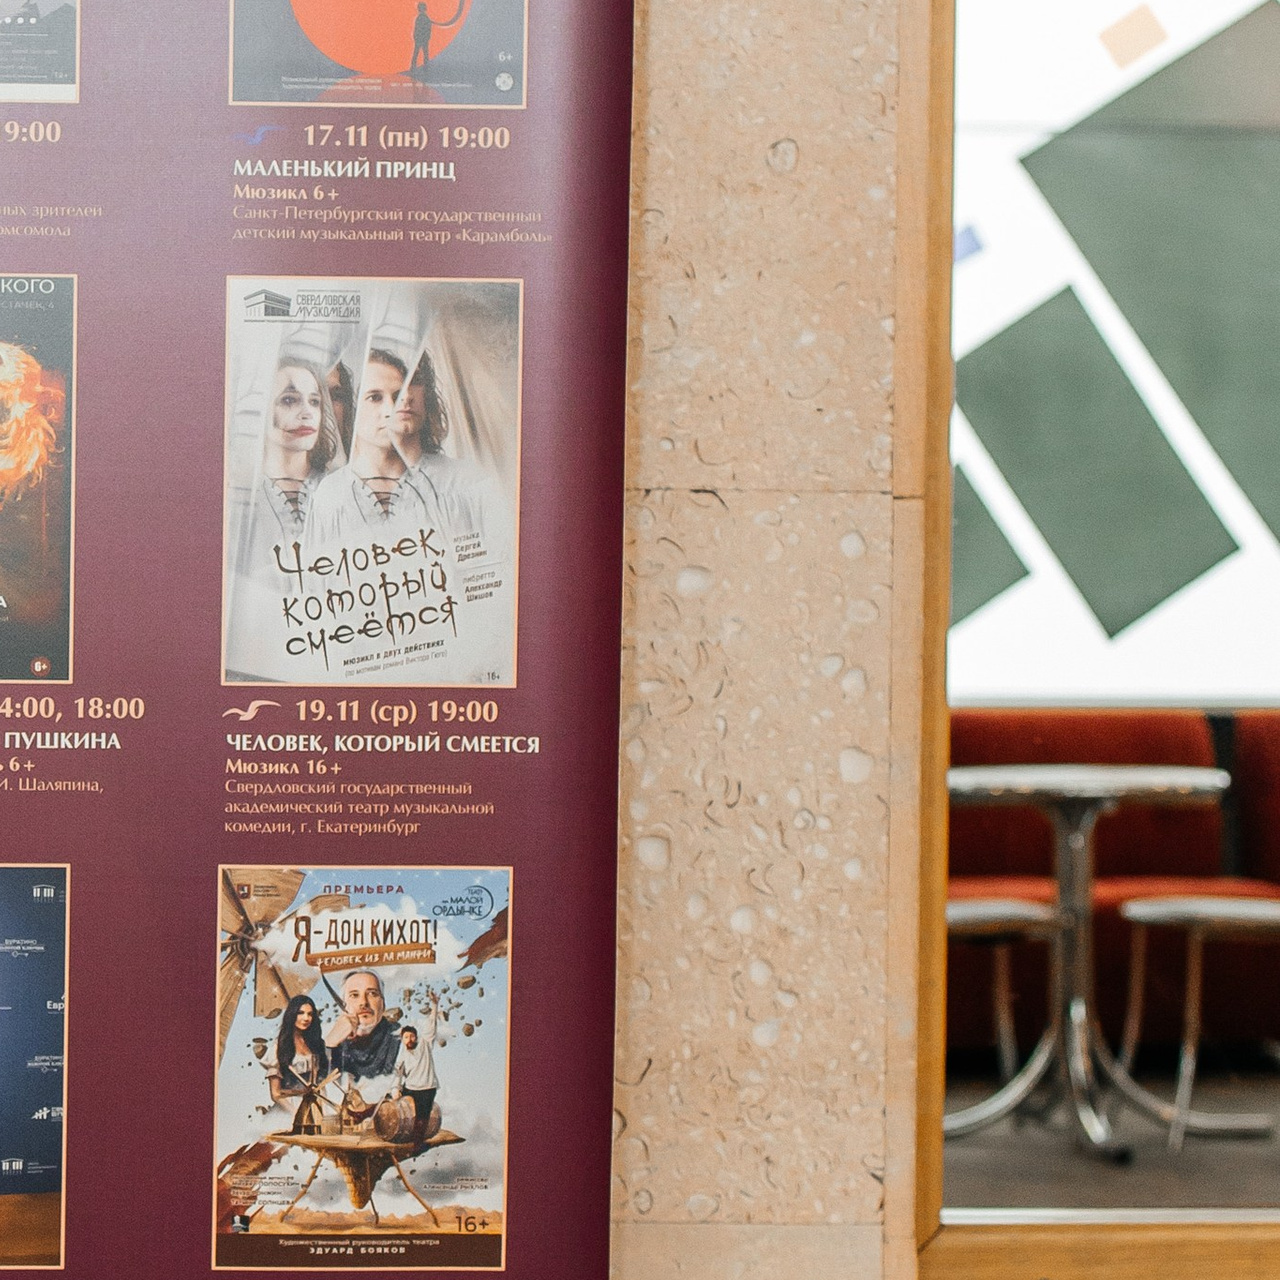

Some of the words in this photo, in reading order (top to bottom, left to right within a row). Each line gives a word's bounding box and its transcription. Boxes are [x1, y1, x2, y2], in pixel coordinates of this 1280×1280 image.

[304, 125, 367, 146] 17.11
[379, 126, 427, 150] (пн)
[439, 127, 509, 148] 19:00
[234, 157, 369, 177] МАЛЕНЬКИЙ
[376, 161, 456, 182] ПРИНЦ
[75, 697, 144, 719] 18:00
[296, 700, 358, 721] 19.11
[371, 700, 416, 727] (ср)
[428, 701, 498, 722] 19:00
[5, 732, 121, 749] ПУШКИНА
[227, 734, 327, 754] ЧЕЛОВЕК,
[335, 732, 440, 751] КОТОРЫЙ
[446, 736, 539, 753] СМЕЕТСЯ
